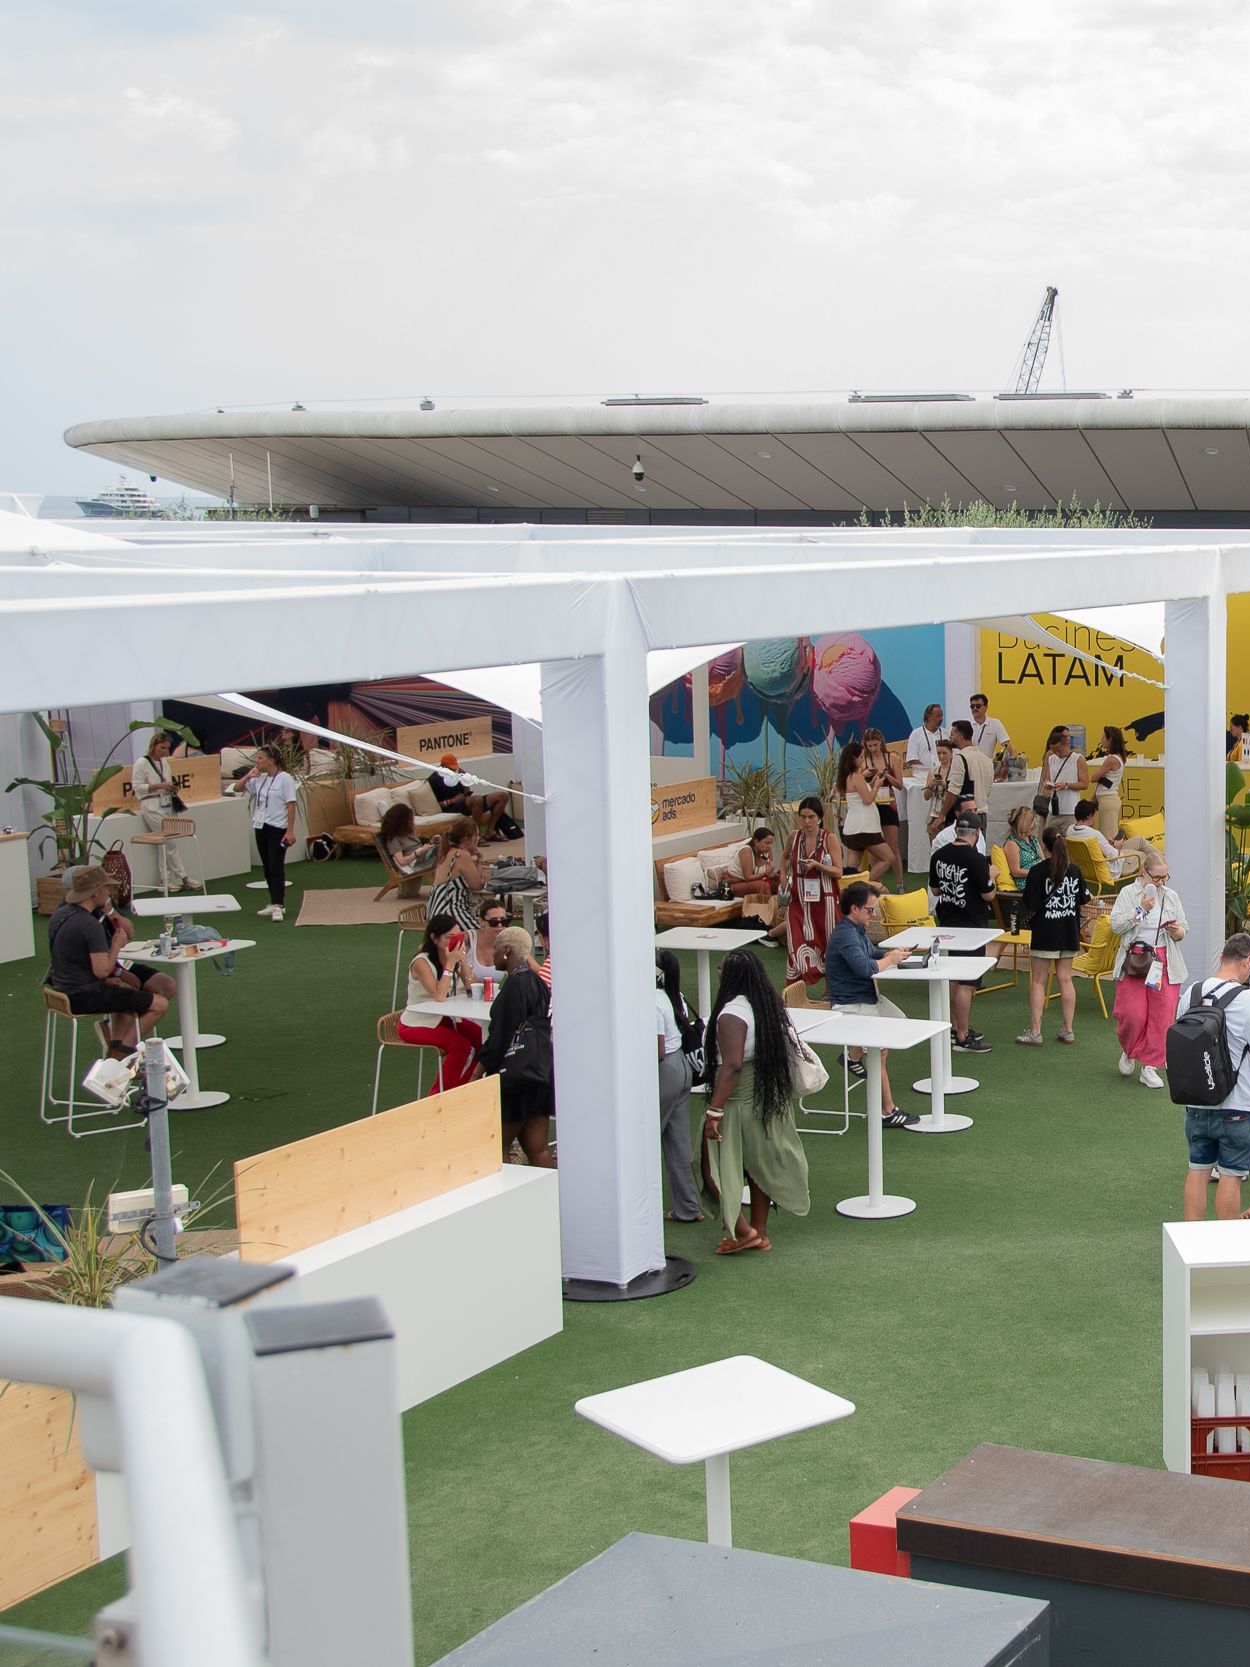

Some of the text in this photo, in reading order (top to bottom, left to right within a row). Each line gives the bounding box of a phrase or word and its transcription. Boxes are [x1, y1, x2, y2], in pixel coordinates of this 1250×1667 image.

[998, 651, 1124, 687] LATAM
[419, 732, 470, 752] PANTONE
[662, 792, 696, 808] mercado
[662, 808, 677, 821] ads
